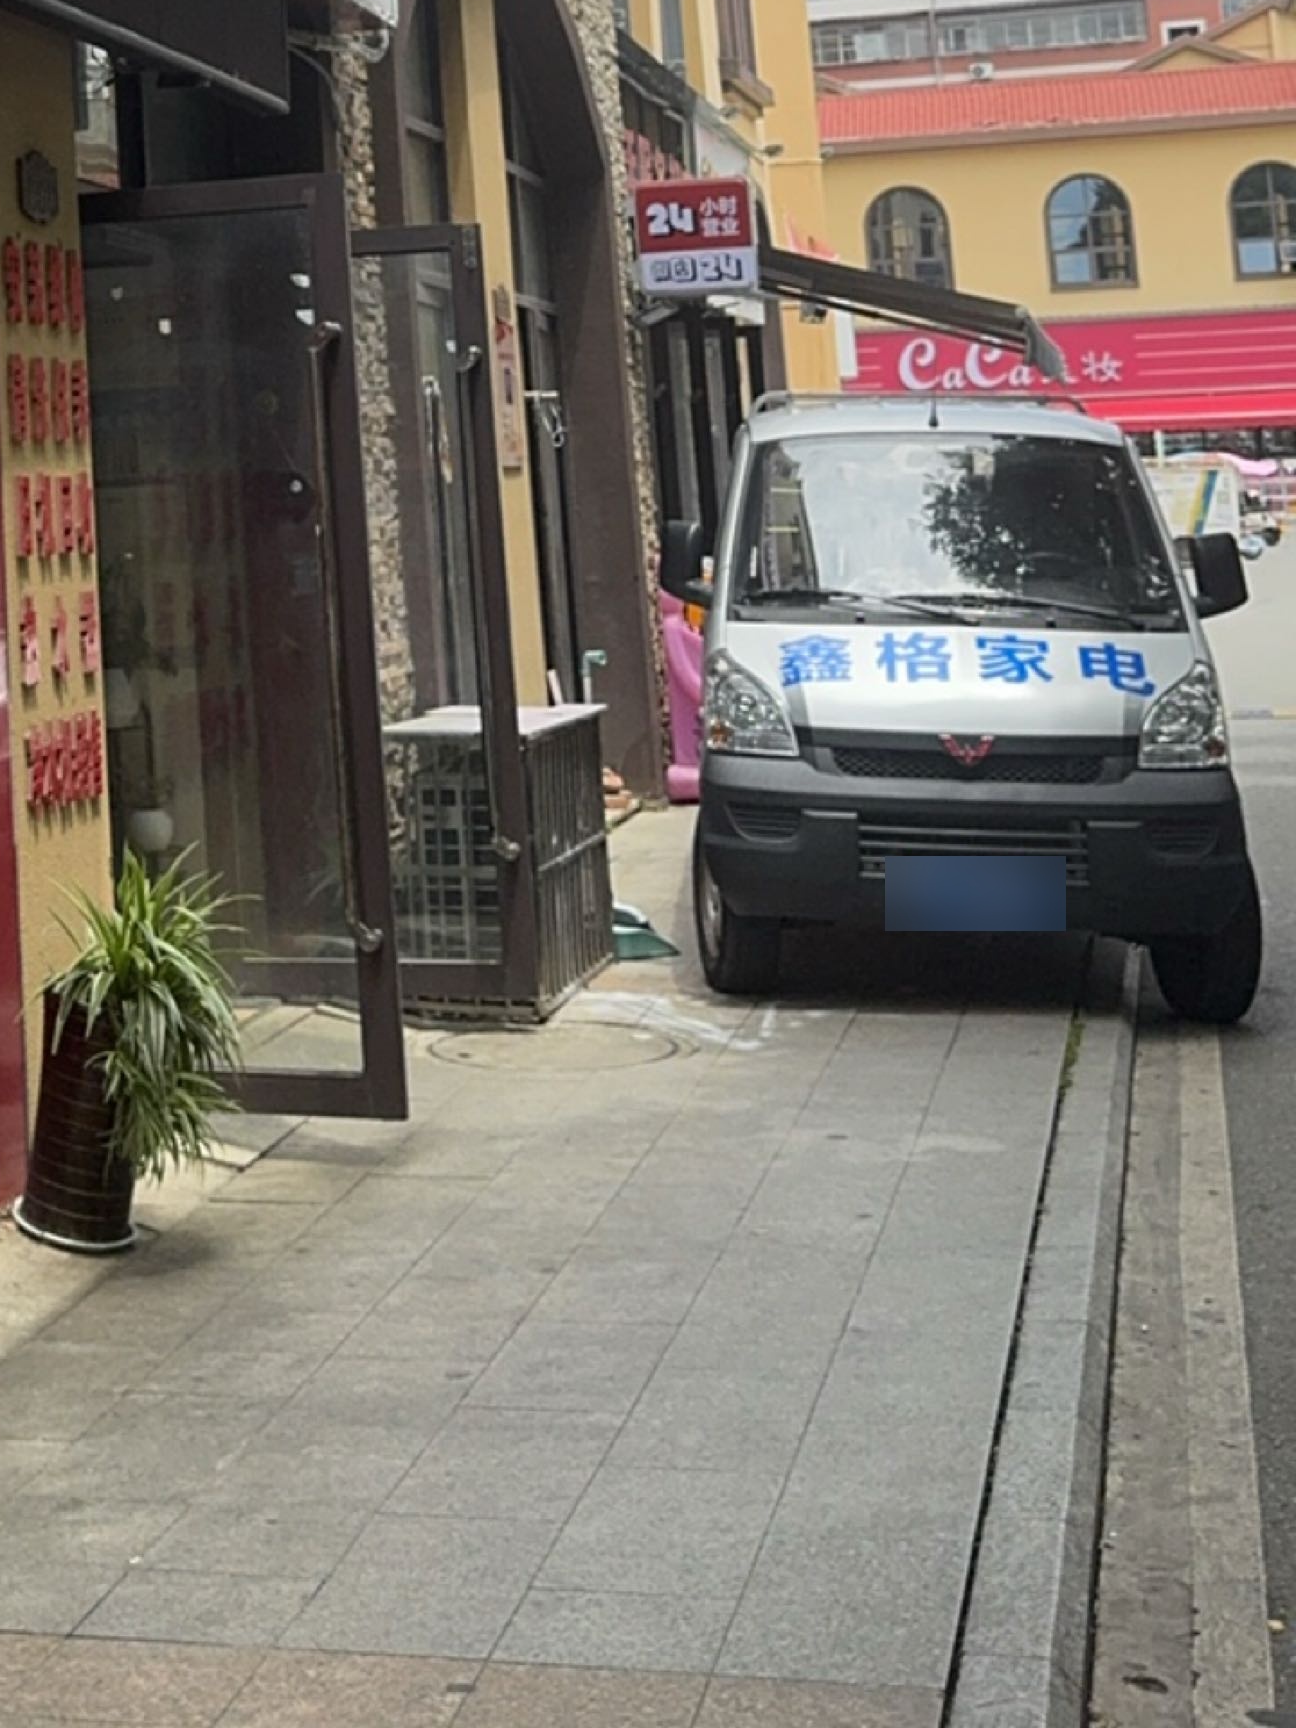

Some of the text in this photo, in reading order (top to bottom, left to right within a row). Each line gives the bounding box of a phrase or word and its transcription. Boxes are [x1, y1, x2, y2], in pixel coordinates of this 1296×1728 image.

[645, 201, 693, 235] 24
[779, 632, 1156, 698] 鑫格家电
